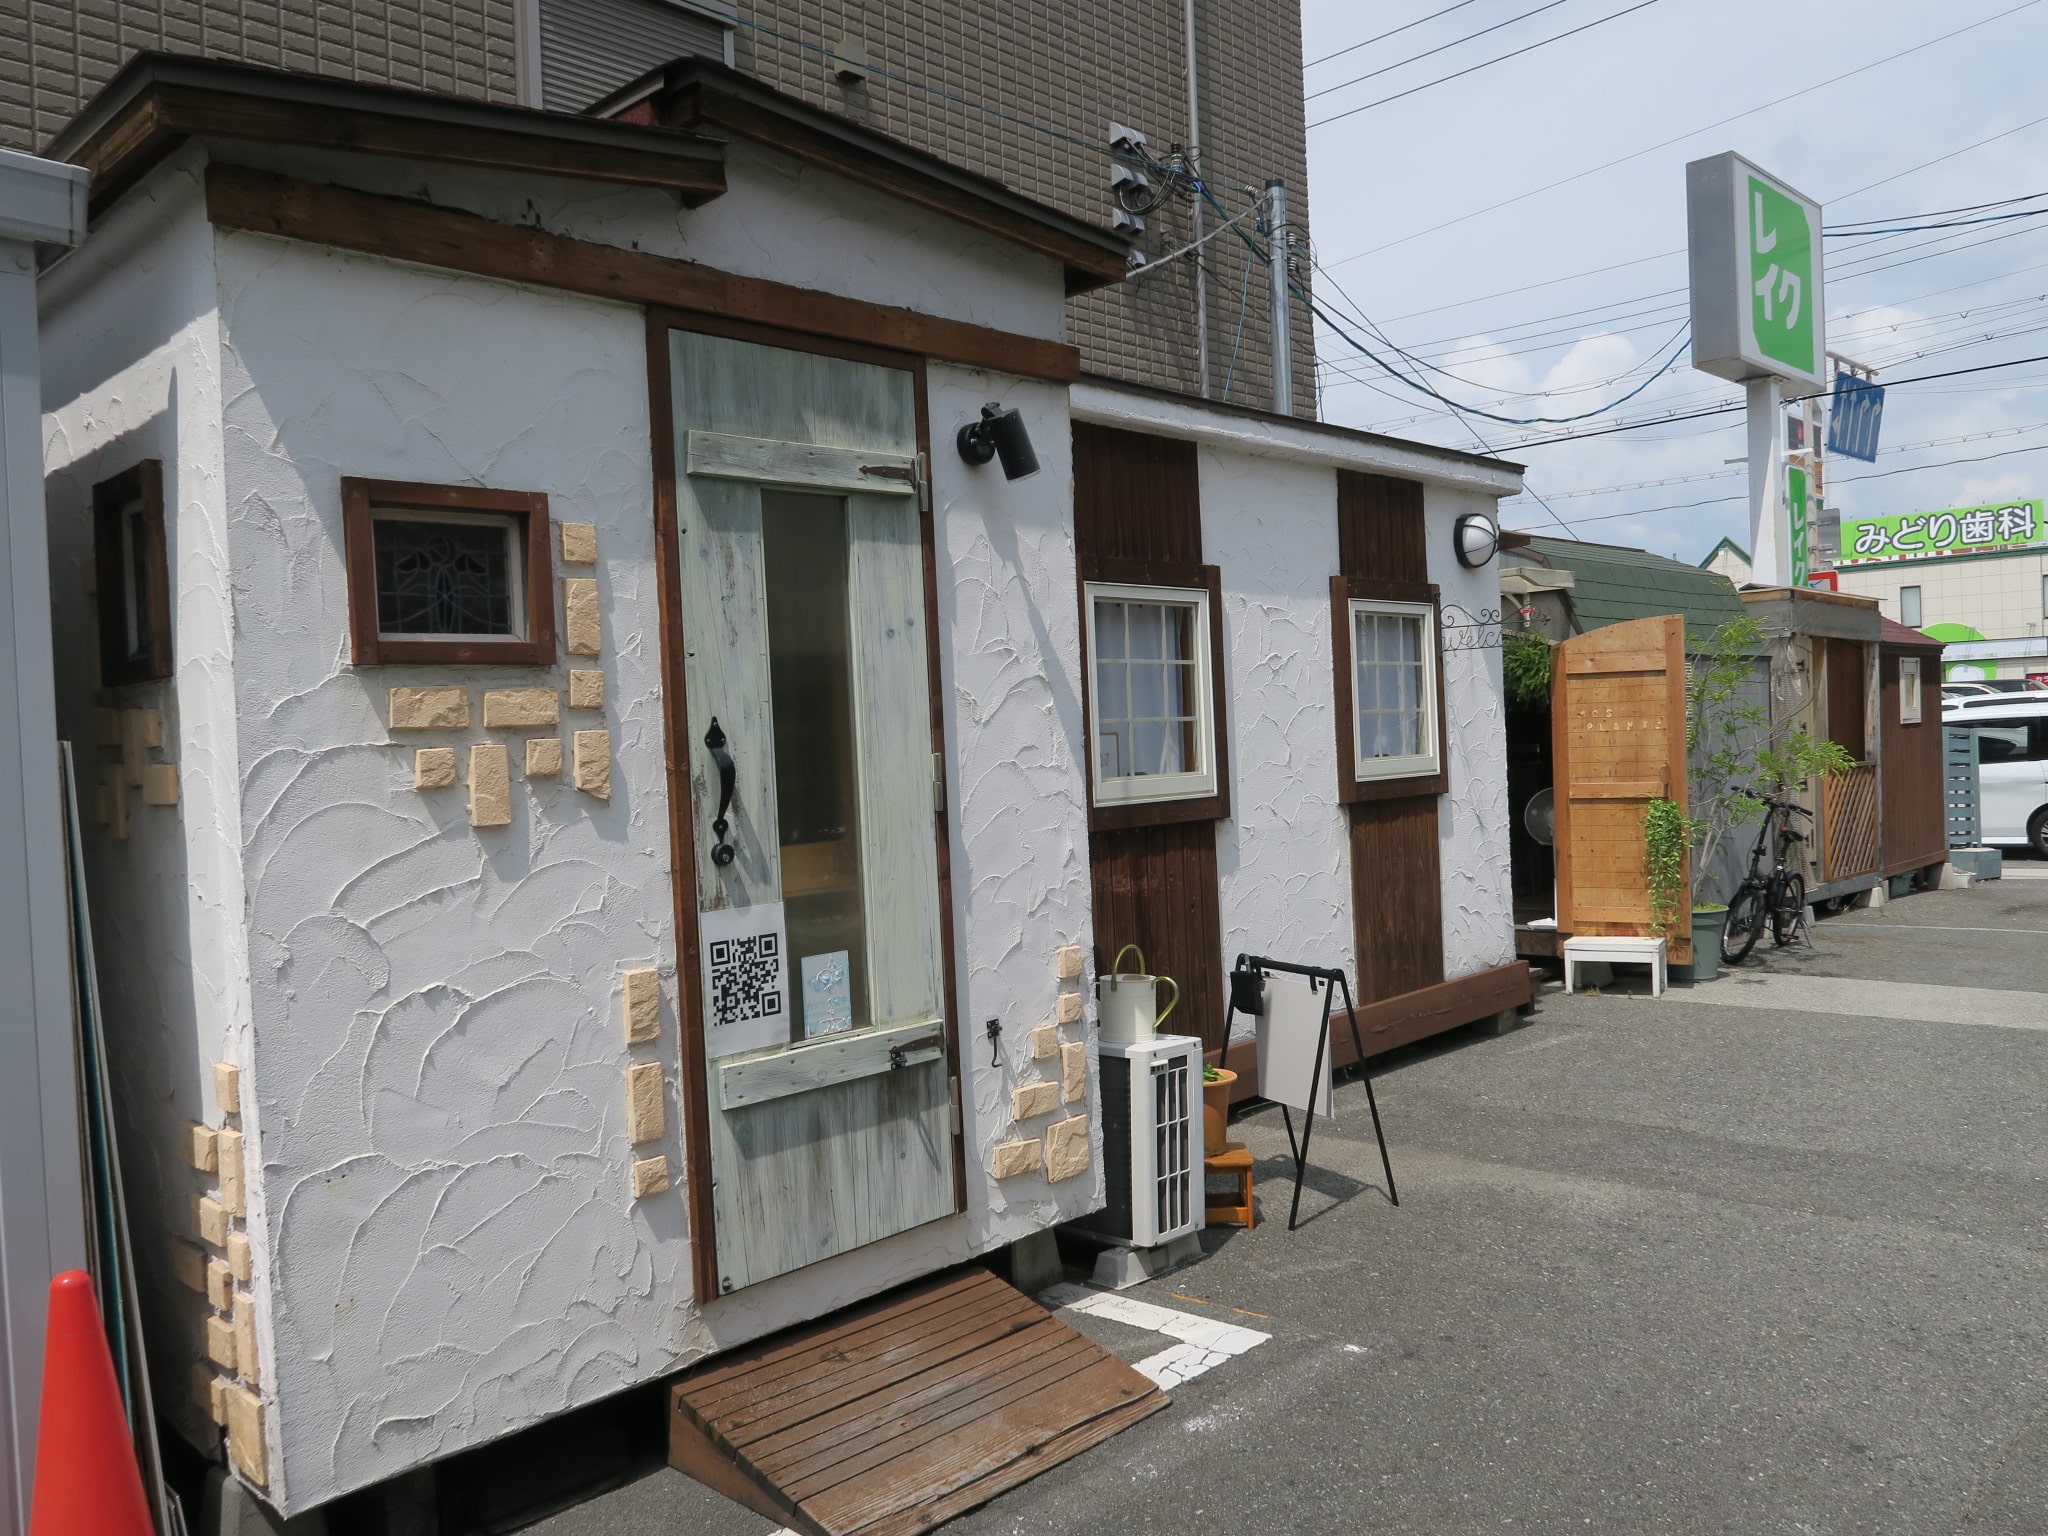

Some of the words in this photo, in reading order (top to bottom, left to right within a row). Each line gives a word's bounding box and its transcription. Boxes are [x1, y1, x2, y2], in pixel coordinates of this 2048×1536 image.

[1754, 191, 1801, 330] レイク
[1855, 504, 2036, 553] みどり歯科
